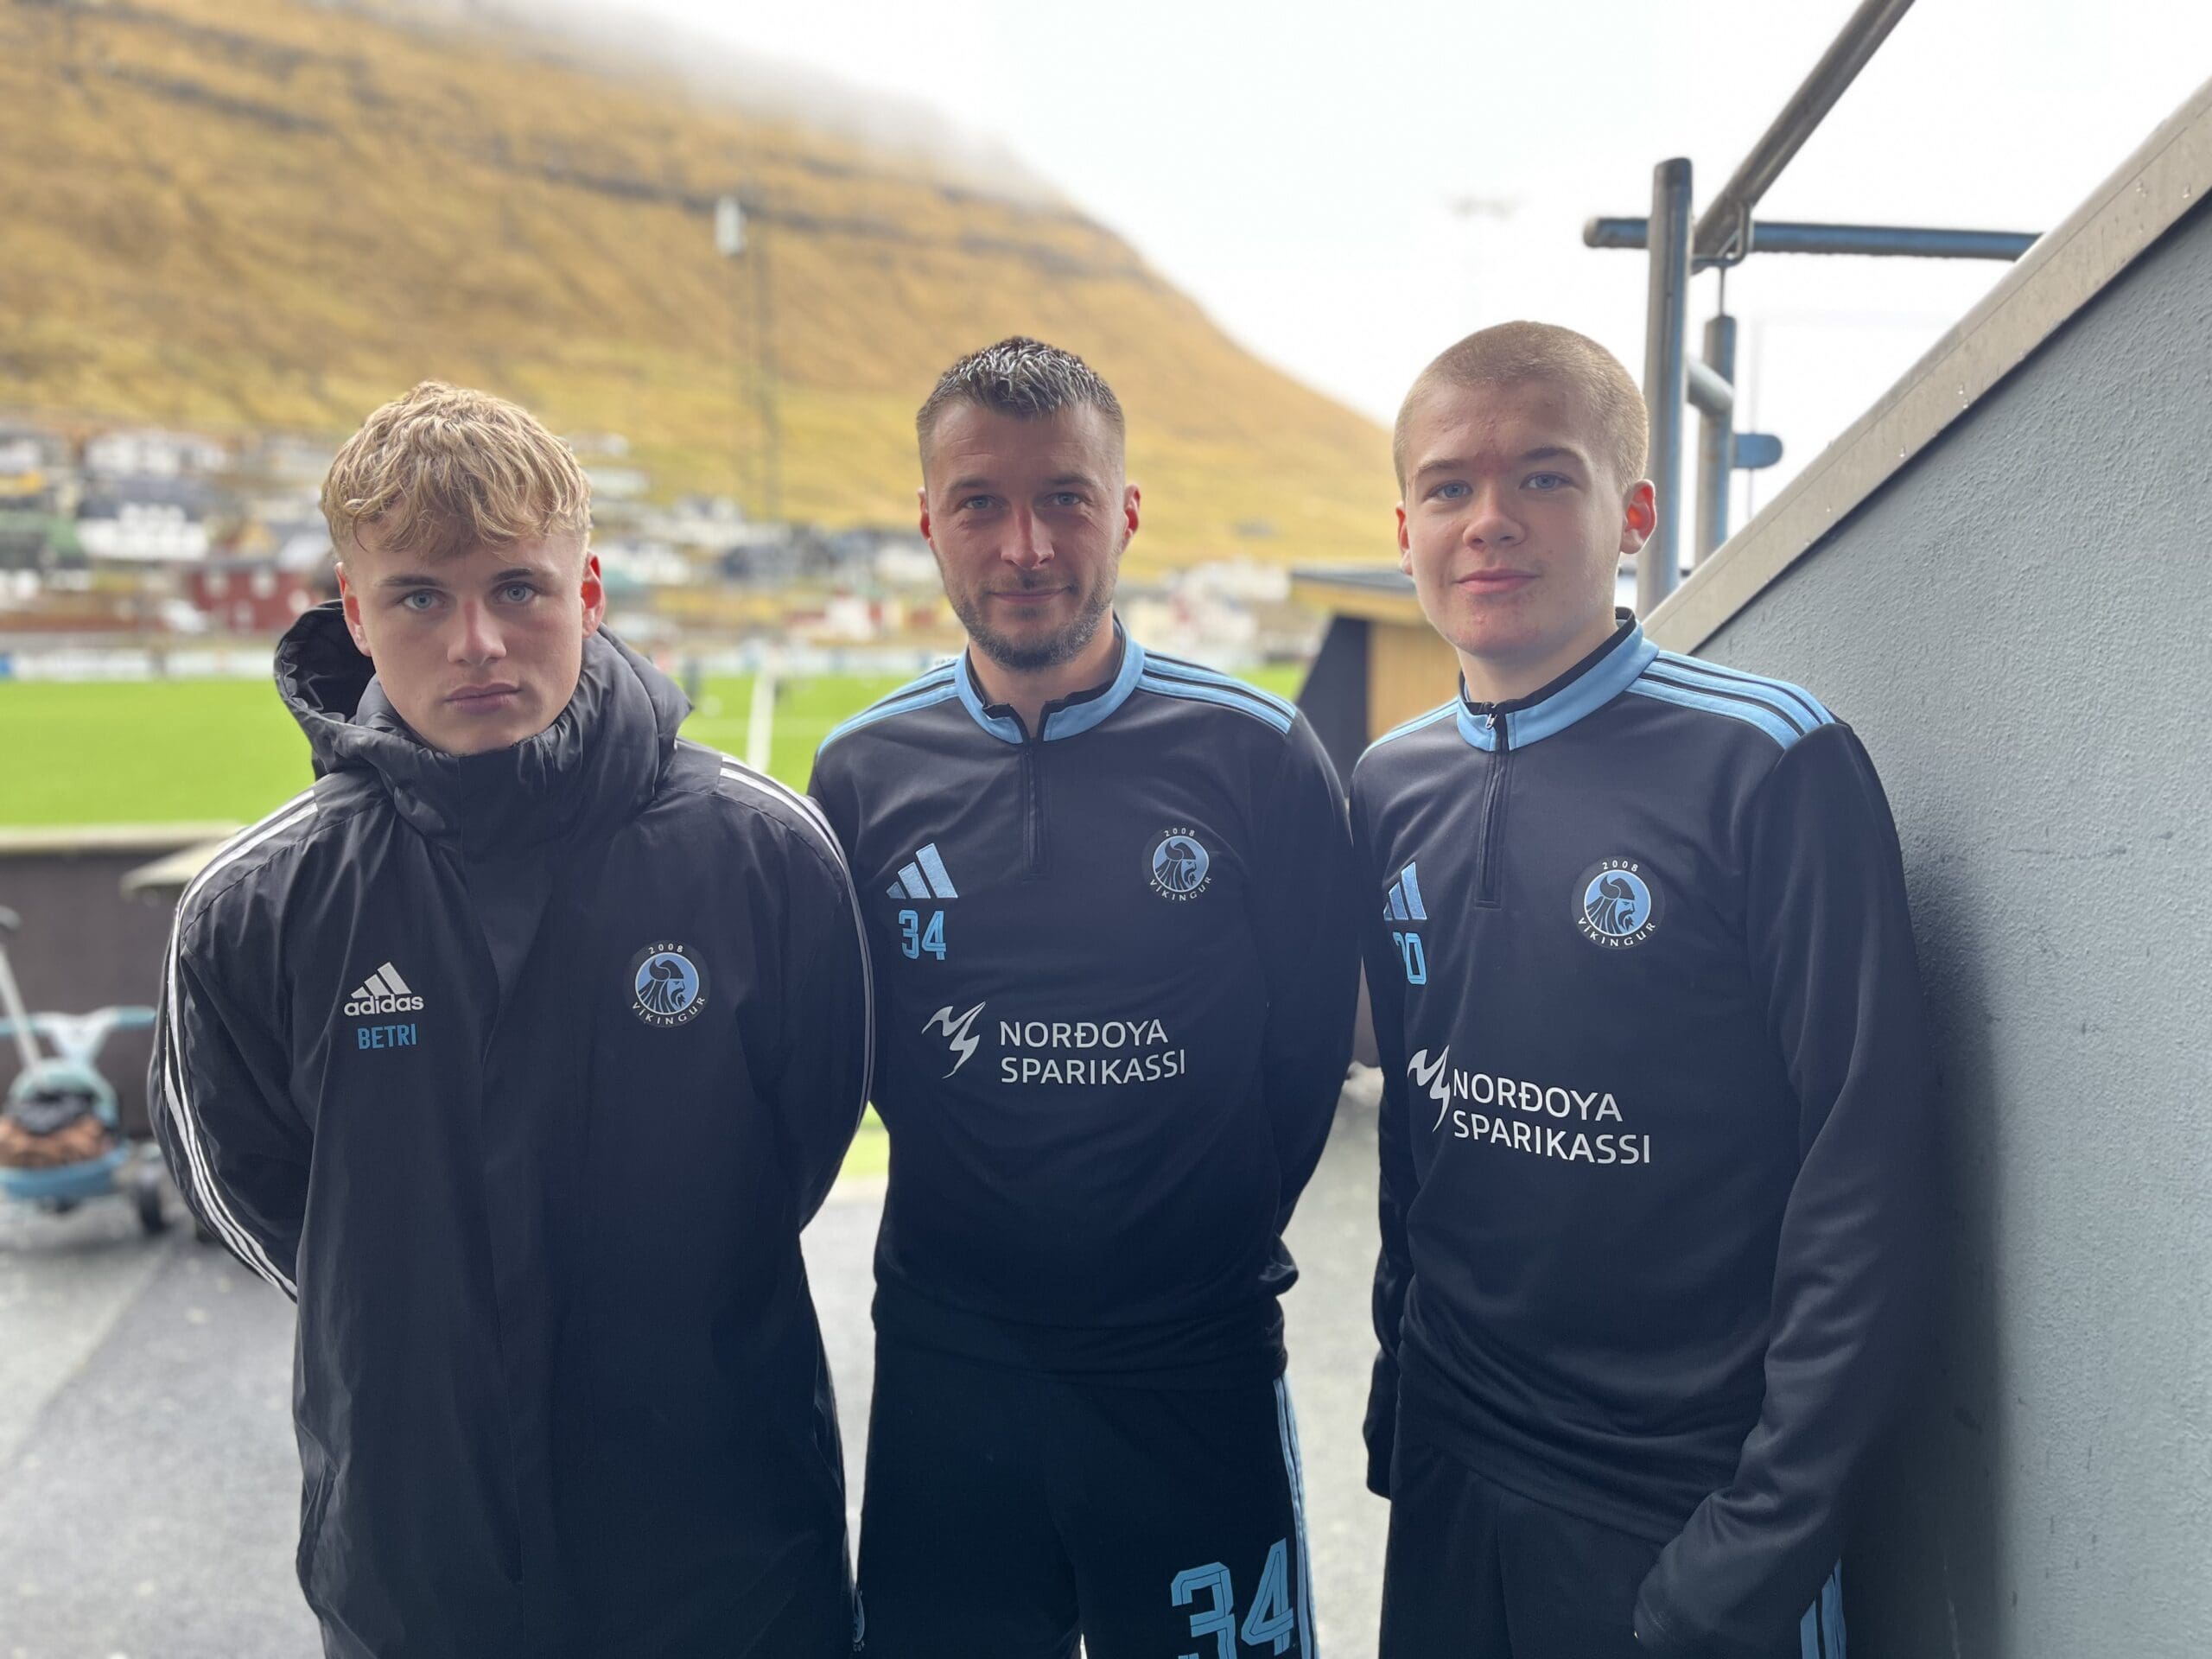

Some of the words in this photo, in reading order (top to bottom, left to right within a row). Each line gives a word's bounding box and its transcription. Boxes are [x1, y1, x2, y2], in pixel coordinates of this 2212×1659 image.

[1164, 828, 1195, 836] 2008
[1602, 860, 1638, 872] 2008
[899, 910, 947, 961] 34
[648, 944, 683, 954] 2008
[344, 994, 424, 1017] adidas
[358, 1024, 417, 1050] BETRI
[1001, 1050, 1185, 1084] SPARIKASSI
[1453, 1110, 1650, 1165] SPARIKASSI
[1171, 1537, 1294, 1659] 34
